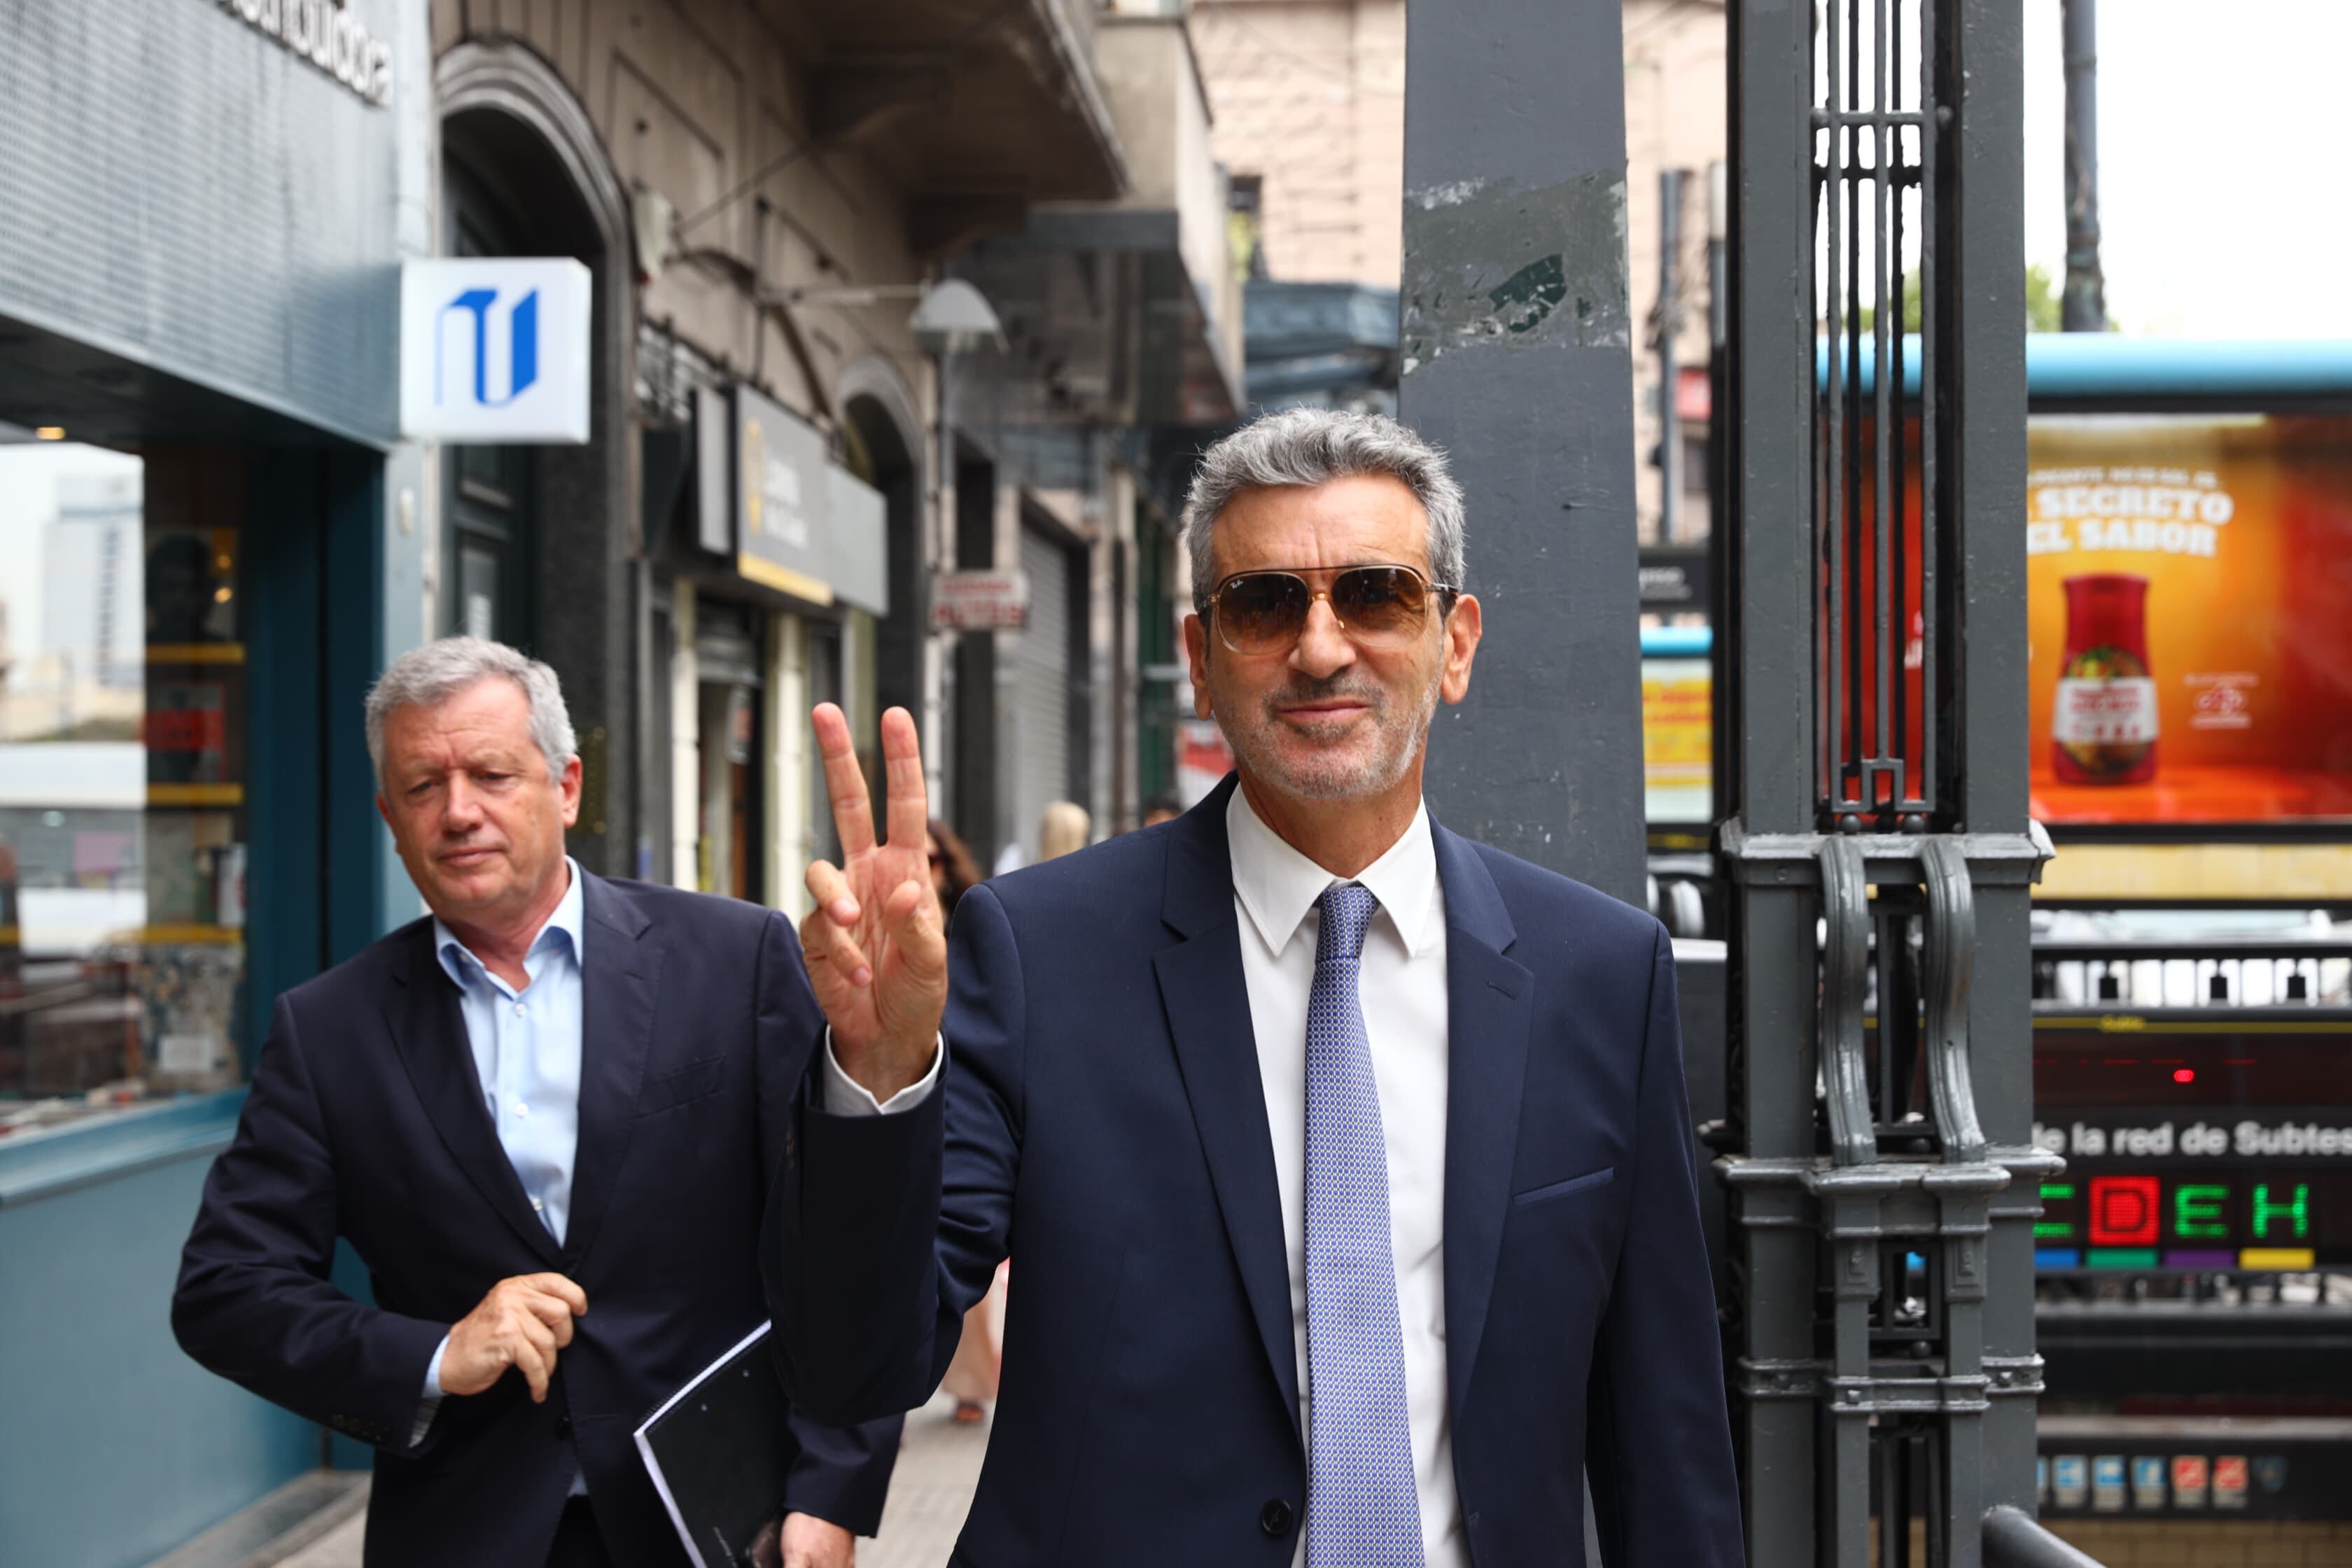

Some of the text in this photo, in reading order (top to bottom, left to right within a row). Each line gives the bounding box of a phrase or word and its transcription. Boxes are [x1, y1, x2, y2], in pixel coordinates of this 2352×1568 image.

[2036, 486, 2234, 526] SECRETO
[2026, 519, 2217, 557] EL SABOR
[2072, 1121, 2106, 1156] la
[2113, 1121, 2174, 1156] red
[2180, 1121, 2228, 1156] de
[2234, 1120, 2352, 1156] Subtes
[2174, 1184, 2230, 1239] E
[2251, 1183, 2309, 1239] H
